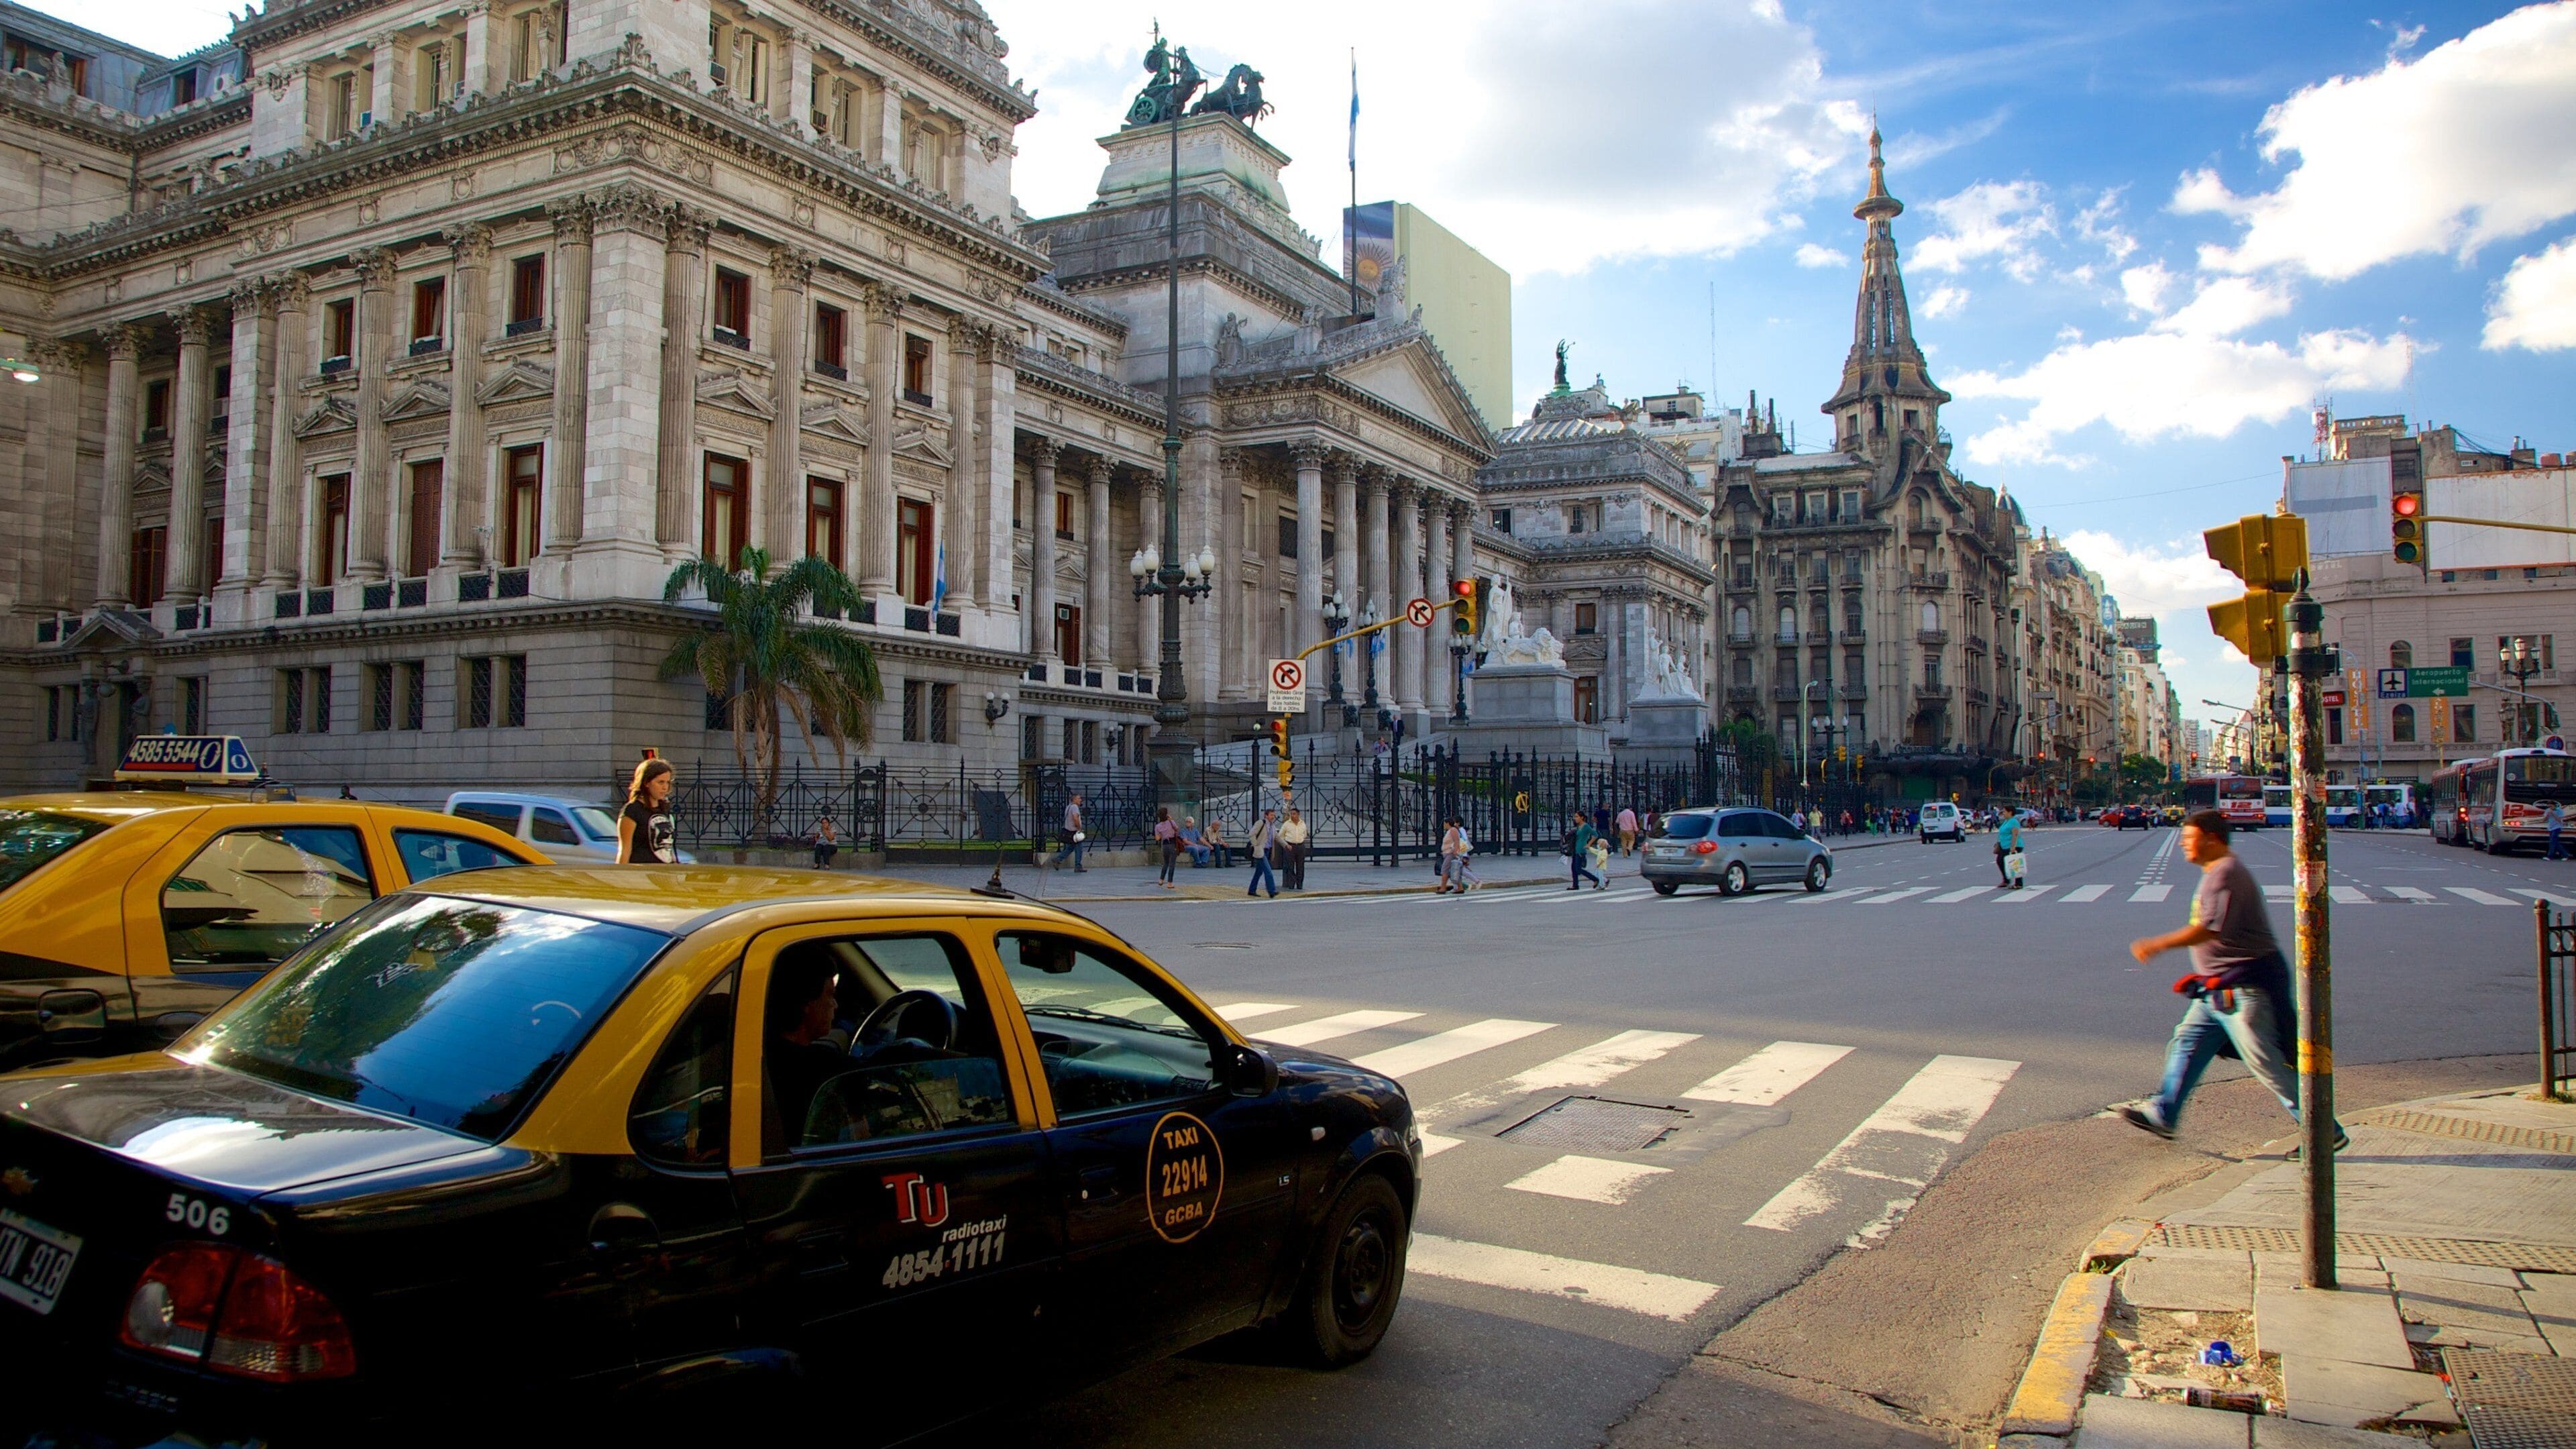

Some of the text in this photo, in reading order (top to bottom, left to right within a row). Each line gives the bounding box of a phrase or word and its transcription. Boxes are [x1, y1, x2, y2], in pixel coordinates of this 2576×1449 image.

[129, 740, 166, 763] 4585
[163, 740, 202, 763] 5544
[2504, 804, 2524, 816] 12
[1163, 1126, 1199, 1149] TAXI
[1163, 1154, 1207, 1197] 22914
[166, 1193, 229, 1236] 506
[1165, 1201, 1203, 1226] GCBA
[942, 1214, 1007, 1243] radiotaxi
[22, 1243, 71, 1297] 918
